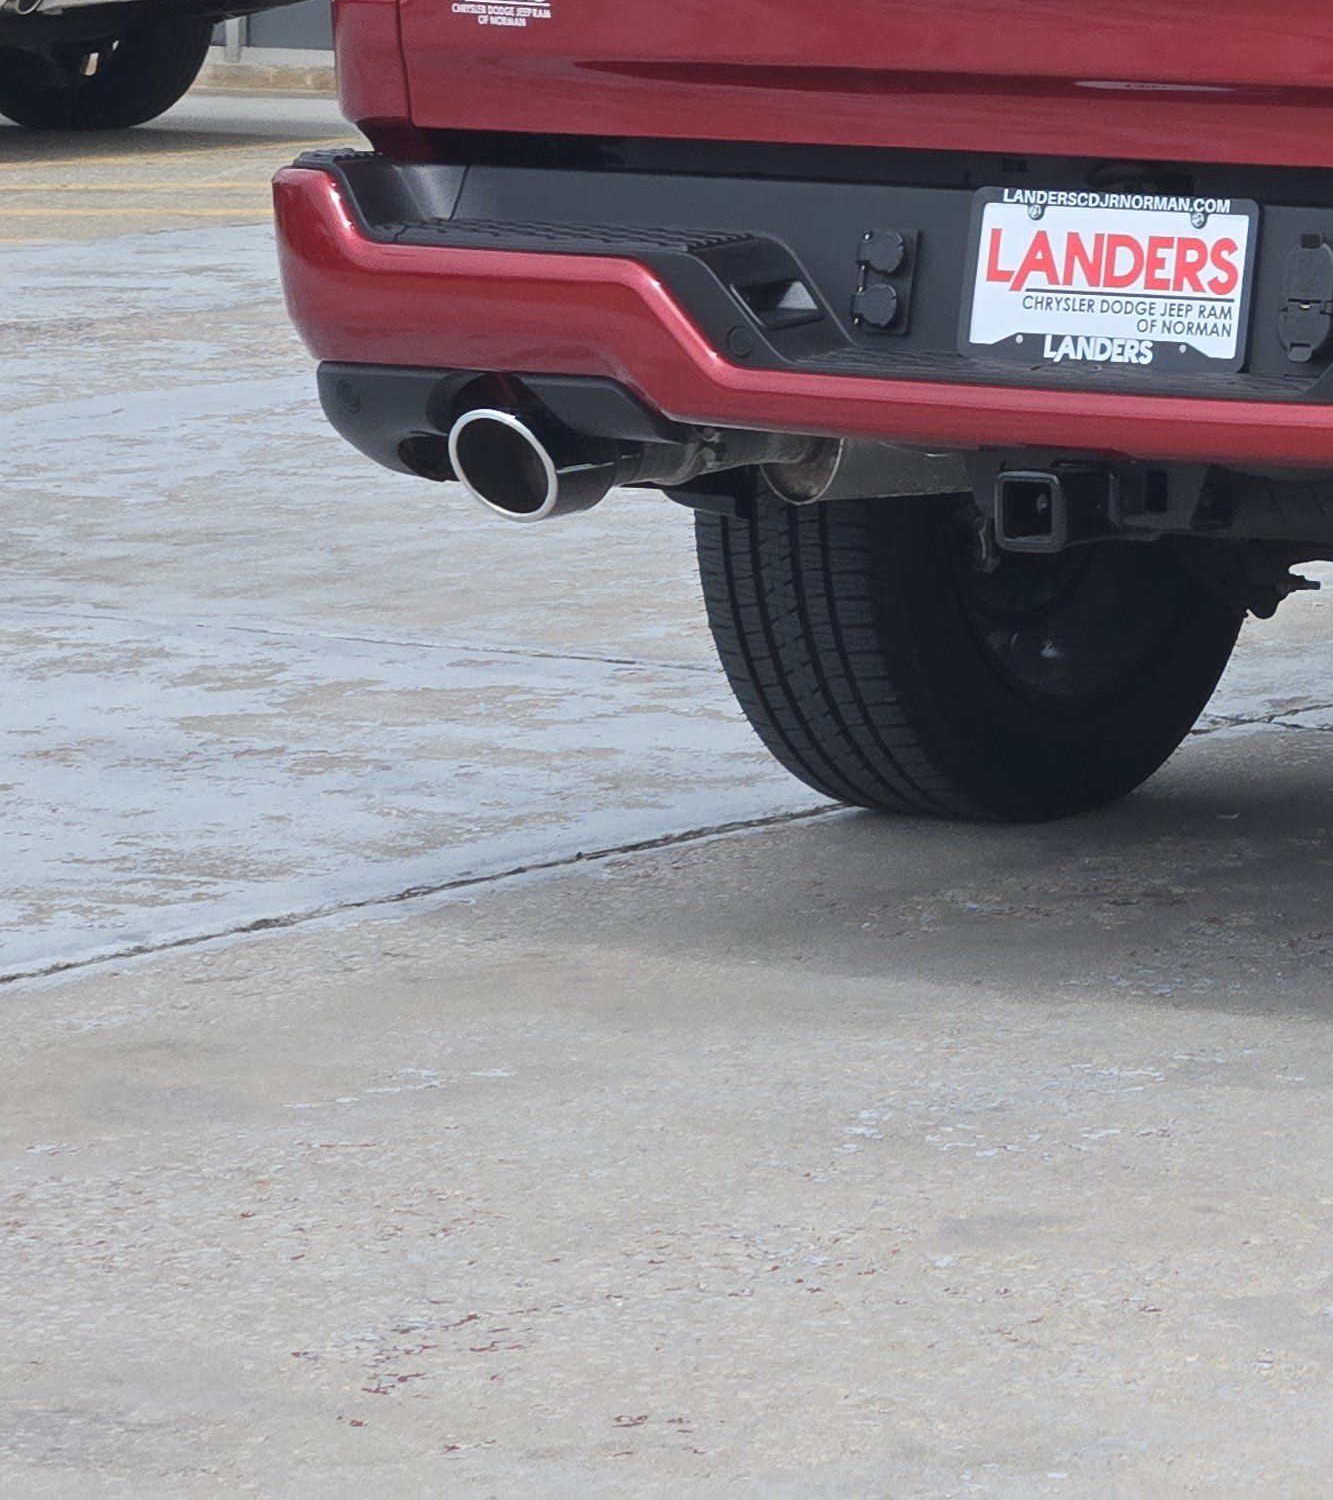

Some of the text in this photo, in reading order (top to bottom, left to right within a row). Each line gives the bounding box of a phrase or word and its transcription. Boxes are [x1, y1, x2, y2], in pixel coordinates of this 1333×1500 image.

[477, 14, 489, 24] OF
[1003, 188, 1232, 214] LANDERSCDJRNORMAN.COM
[985, 227, 1239, 296] LANDERS
[1022, 295, 1233, 321] CHRYSLER DODGE JEEP RAM
[1136, 318, 1232, 339] OF NORMAN
[1043, 334, 1154, 366] LANDERS
